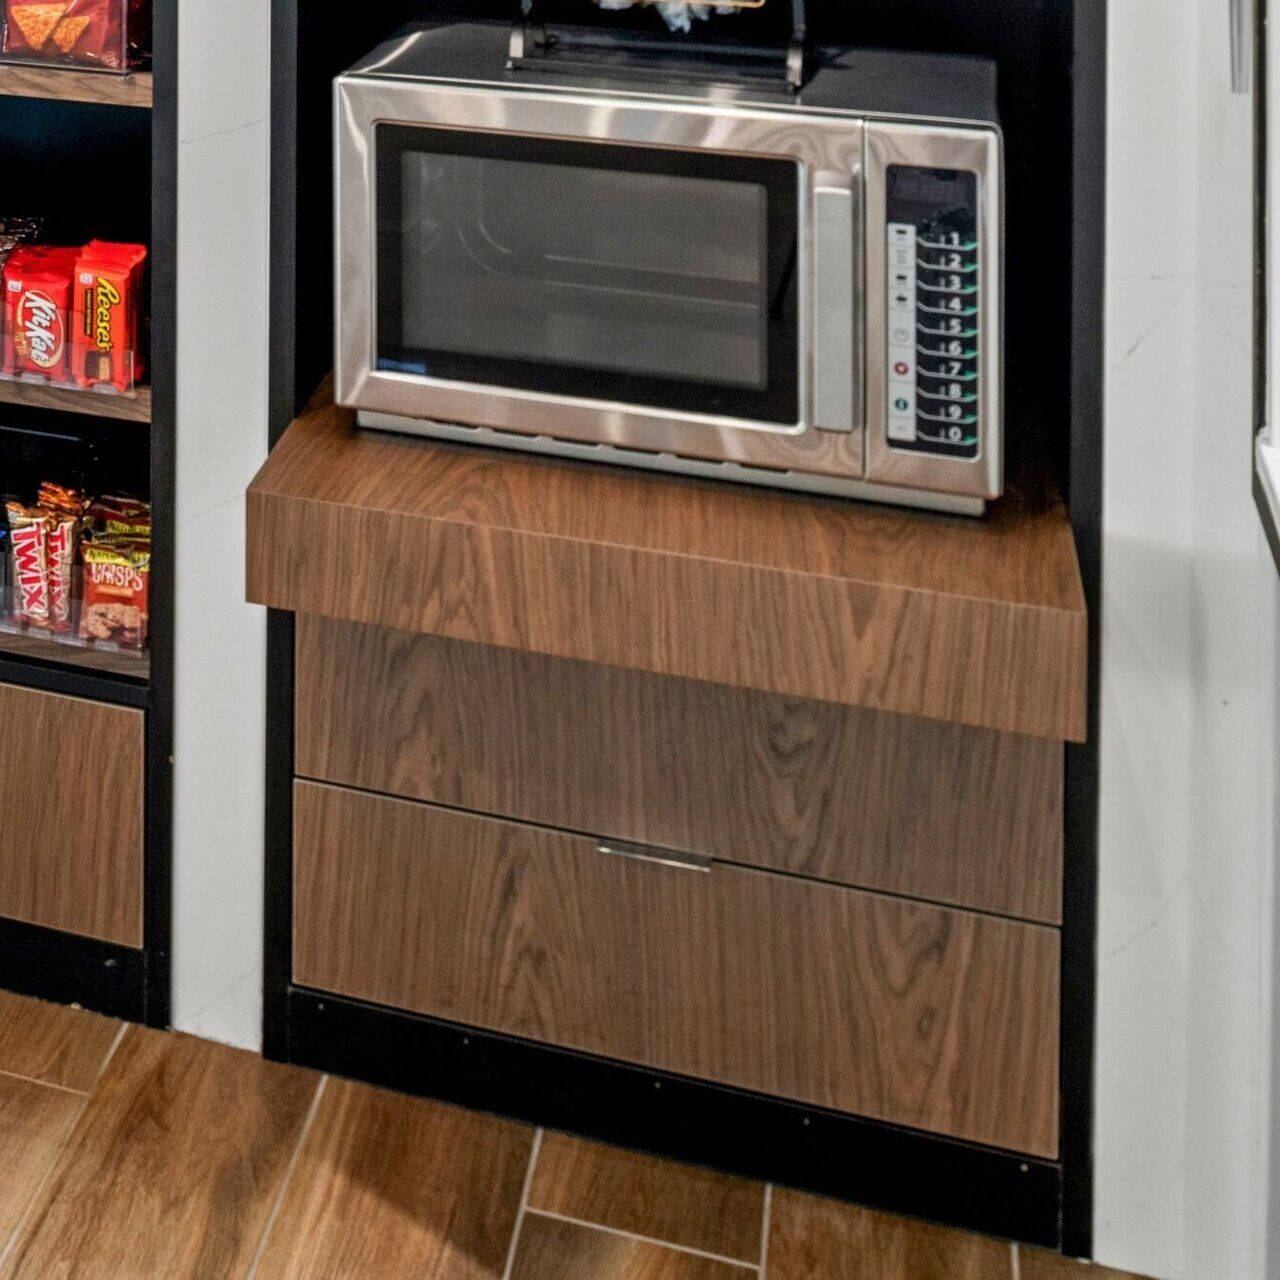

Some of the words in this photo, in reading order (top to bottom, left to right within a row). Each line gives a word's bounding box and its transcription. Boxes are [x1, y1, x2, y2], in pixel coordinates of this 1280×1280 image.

[951, 232, 959, 245] 1
[949, 254, 961, 268] 2
[949, 276, 961, 289] 3
[949, 298, 961, 311] 4
[950, 320, 961, 333] 5
[949, 342, 961, 355] 6
[950, 362, 961, 375] 7
[949, 384, 961, 398] 8
[949, 405, 961, 418] 9
[949, 426, 961, 439] 0
[12, 521, 45, 612] TWIX
[91, 563, 143, 591] CRISPS
